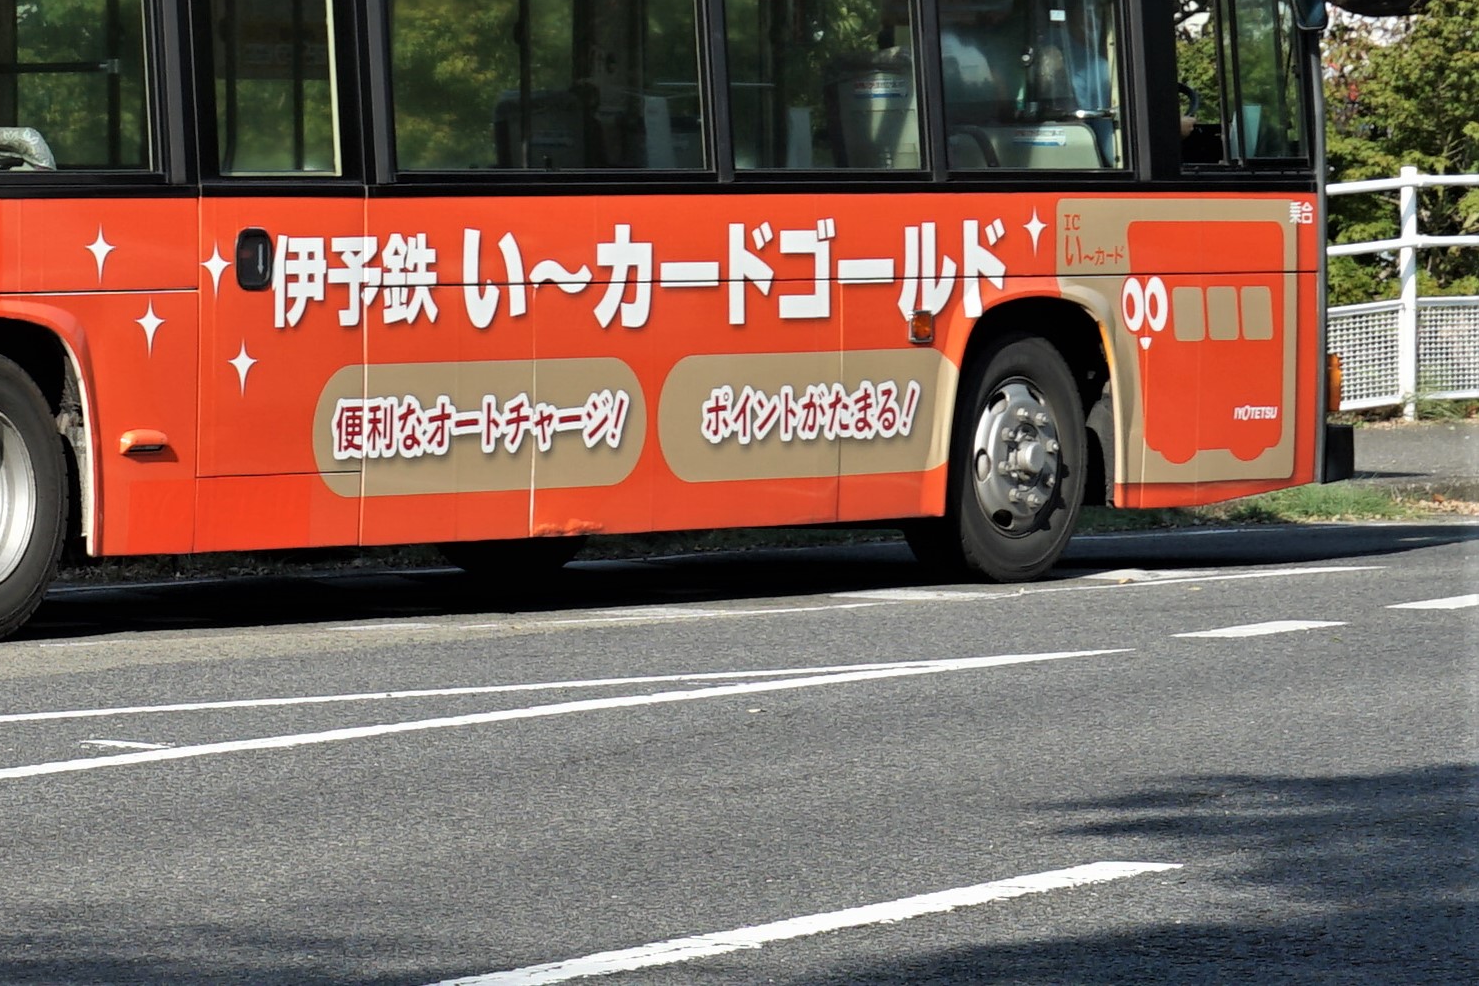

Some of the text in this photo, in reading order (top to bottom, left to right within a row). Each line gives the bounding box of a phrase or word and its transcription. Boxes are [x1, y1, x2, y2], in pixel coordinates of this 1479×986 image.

[1064, 214, 1081, 230] IC
[1289, 201, 1313, 224] 乗合
[272, 233, 439, 329] 伊予鉄
[332, 389, 629, 460] 便利なオートチャージ!
[701, 380, 921, 444] ポイントがたまる!
[1233, 404, 1278, 421] IYOTETSU
